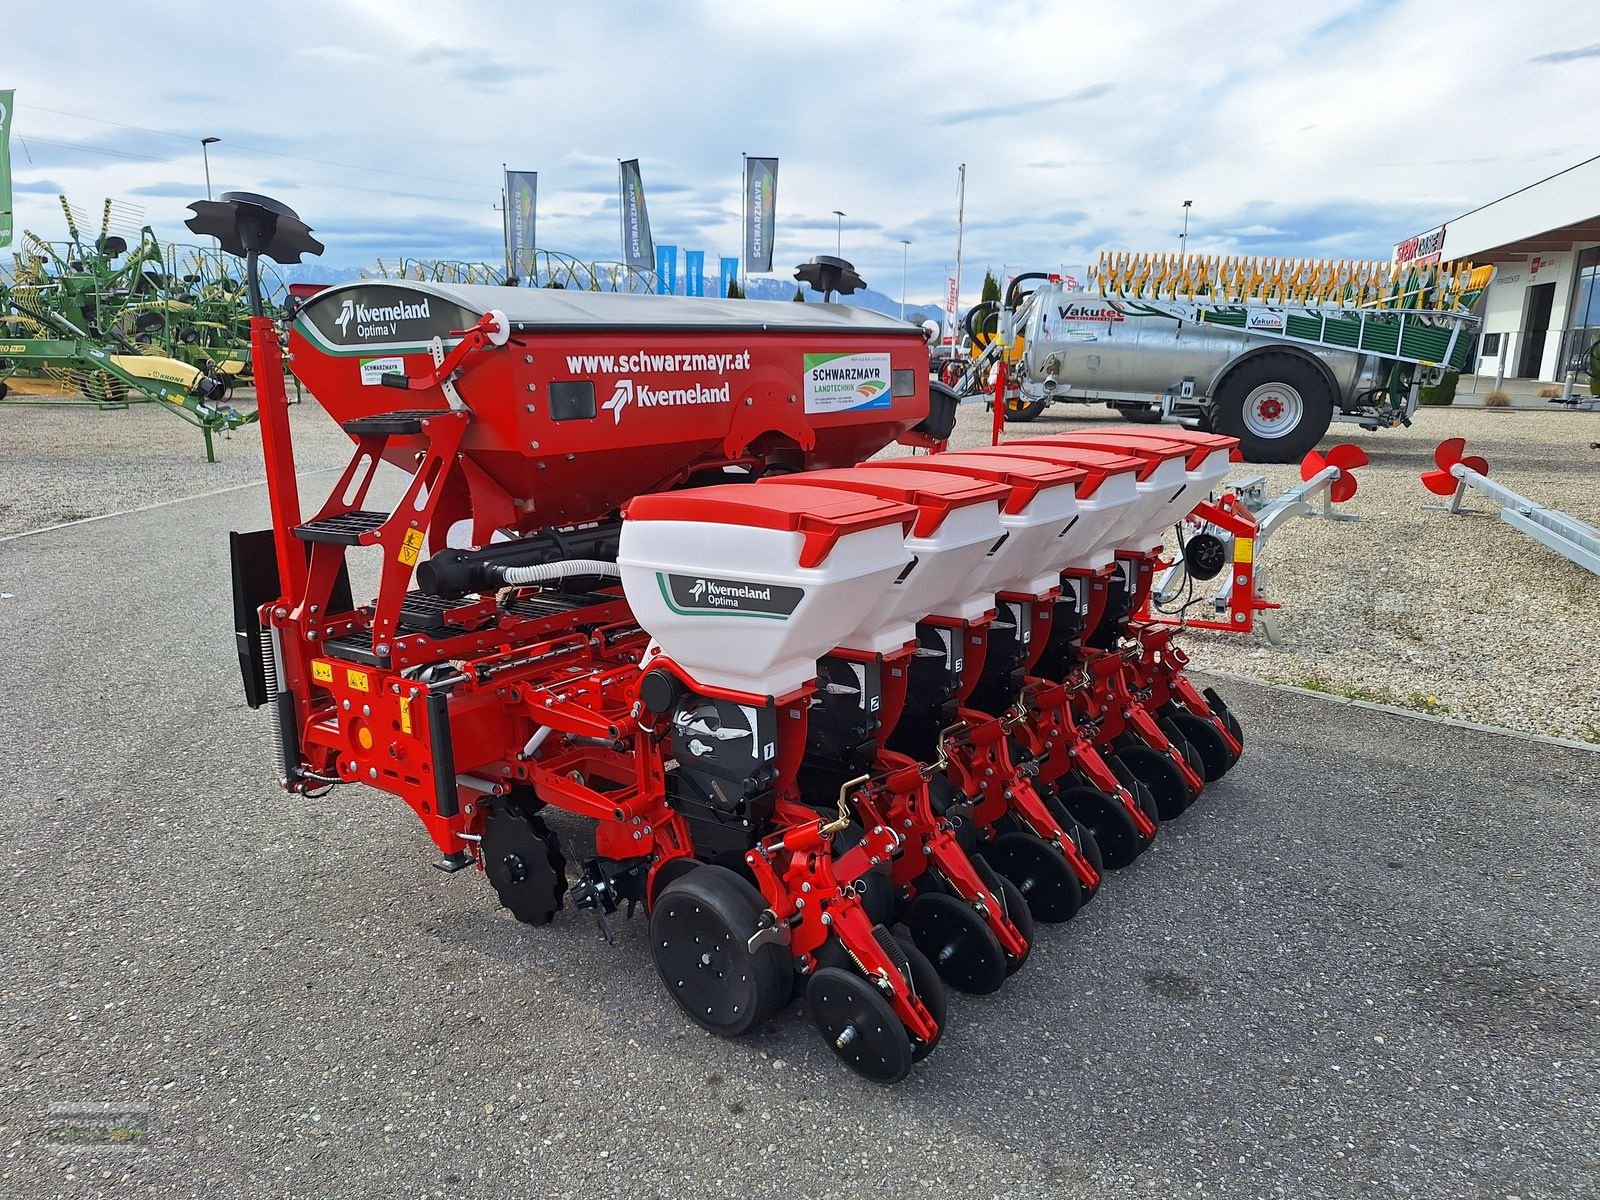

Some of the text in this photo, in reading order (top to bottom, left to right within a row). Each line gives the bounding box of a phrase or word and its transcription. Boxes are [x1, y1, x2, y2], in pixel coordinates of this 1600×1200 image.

[629, 183, 641, 258] SCHWARZMAYR
[753, 181, 762, 258] SCHWARZMAYR
[356, 298, 430, 323] Kverneland
[1251, 316, 1281, 325] Vakutec
[357, 322, 396, 339] Optima V
[566, 349, 751, 375] www.schwarzmayr.at
[160, 374, 184, 383] KRONE
[812, 368, 880, 381] SCHWARZMAYR
[637, 382, 730, 407] Kverneland
[814, 384, 855, 393] LANDTECHNIK
[708, 582, 770, 600] Kverneland
[708, 595, 739, 607] Optima
